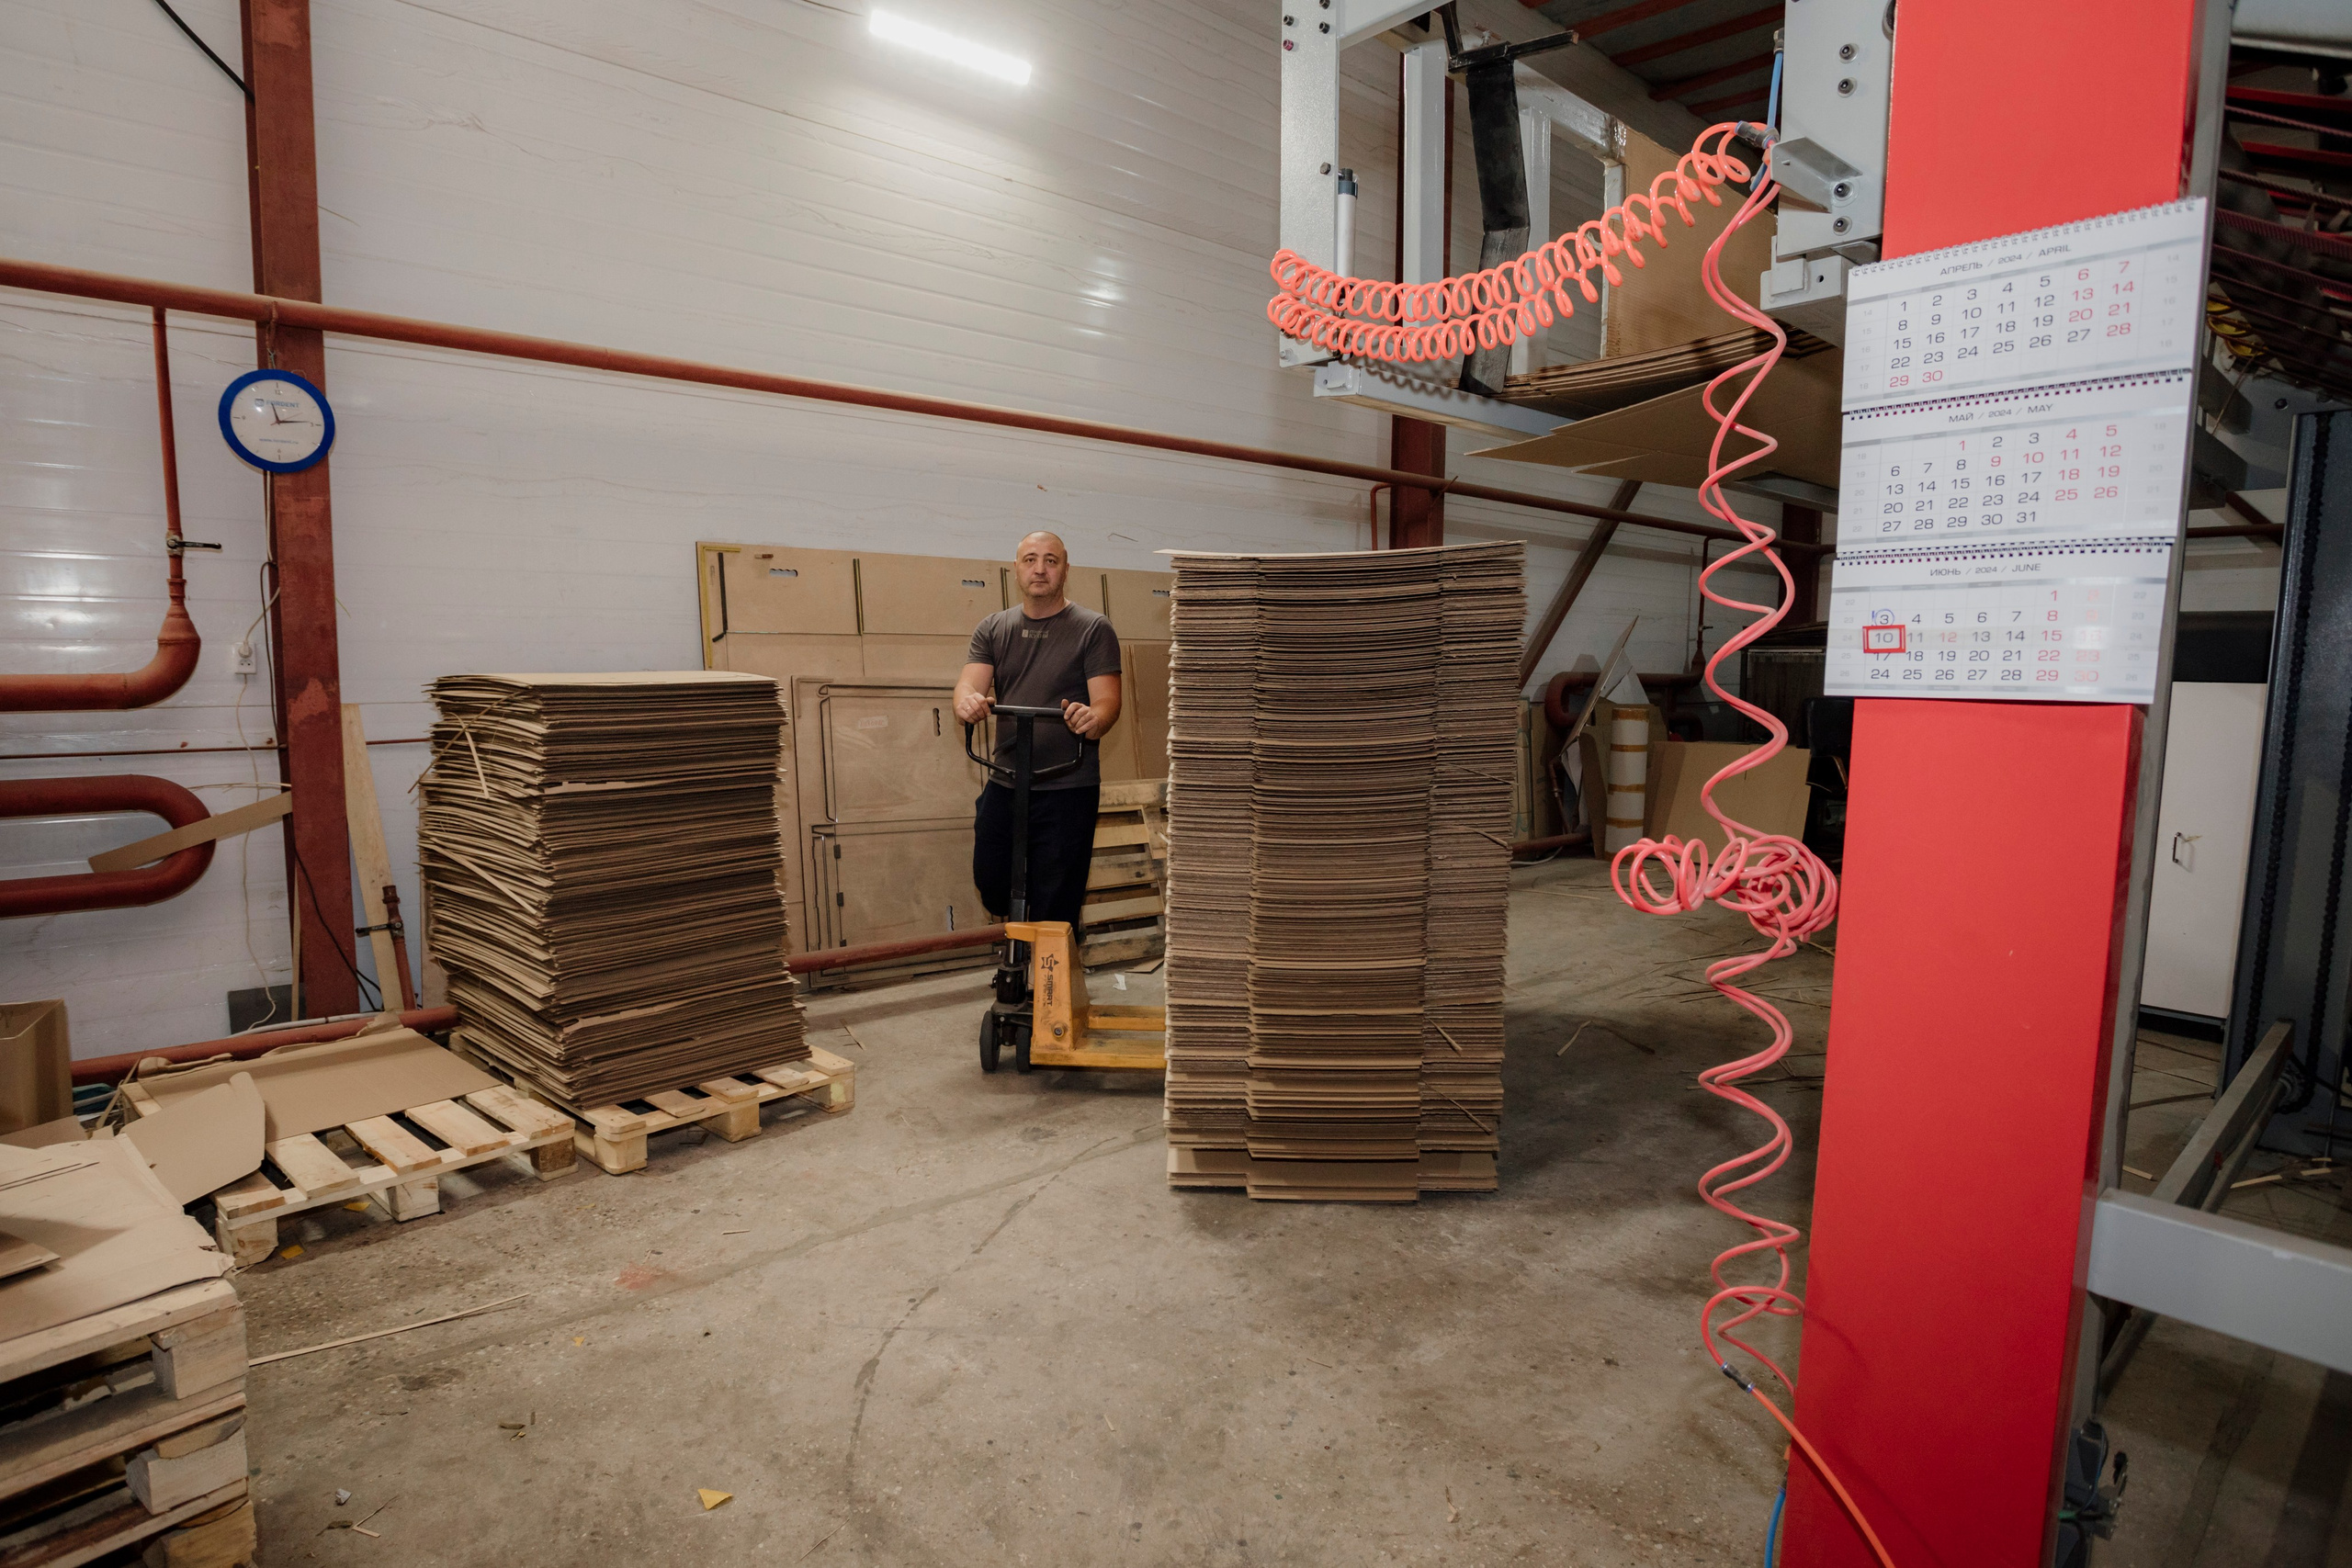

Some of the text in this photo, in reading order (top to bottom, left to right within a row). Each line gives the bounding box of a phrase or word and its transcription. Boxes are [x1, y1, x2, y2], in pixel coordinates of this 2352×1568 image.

[1939, 261, 1984, 276] АПРЕЛЬ
[1998, 254, 2022, 265] 2024
[2038, 243, 2072, 257] APRIL
[1863, 309, 1872, 317] 14
[1900, 300, 1907, 312] 1
[1932, 294, 1942, 307] 2
[1966, 288, 1977, 300] 3
[2002, 281, 2013, 293] 4
[2040, 275, 2051, 288] 5
[2077, 268, 2089, 281] 6
[2120, 260, 2130, 274] 7
[1897, 319, 1908, 332] 8
[1930, 313, 1941, 326] 9
[1962, 307, 1983, 320] 10
[1997, 300, 2015, 315] 11
[2034, 294, 2055, 308] 12
[2073, 288, 2094, 301] 13
[2112, 280, 2134, 295] 14
[1860, 345, 1871, 354] 16
[1893, 337, 1912, 350] 15
[1926, 332, 1945, 344] 16
[1960, 326, 1980, 340] 17
[1996, 321, 2017, 333] 18
[2032, 314, 2053, 328] 19
[2068, 308, 2093, 323] 20
[2108, 301, 2131, 317] 21
[1891, 355, 1911, 369] 22
[1923, 351, 1944, 365] 23
[1957, 345, 1979, 359] 24
[1992, 340, 2015, 355] 25
[2029, 334, 2052, 349] 26
[2066, 328, 2091, 344] 27
[2106, 322, 2132, 337] 28
[1889, 375, 1909, 388] 29
[1922, 369, 1943, 383] 30
[1949, 412, 1974, 423] МАЙ
[1988, 409, 2012, 418] 2024
[2027, 403, 2053, 413] MAY
[1857, 452, 1867, 460] 18
[1959, 440, 1965, 451] 1
[1992, 435, 2003, 448] 2
[2028, 432, 2040, 445] 3
[2065, 428, 2077, 440] 4
[2105, 424, 2118, 437] 5
[1856, 470, 1866, 479] 19
[1890, 465, 1901, 477] 6
[1923, 462, 1933, 474] 7
[1956, 458, 1967, 471] 8
[1990, 456, 2002, 468] 9
[2023, 451, 2044, 464] 10
[2061, 448, 2079, 461] 11
[2100, 445, 2122, 457] 12
[1885, 483, 1905, 496] 13
[1917, 480, 1937, 492] 14
[1951, 477, 1971, 490] 15
[1985, 474, 2006, 487] 16
[2021, 471, 2042, 484] 17
[2059, 468, 2080, 480] 18
[2098, 465, 2120, 478] 19
[1883, 502, 1904, 514] 20
[1915, 499, 1933, 512] 21
[1948, 496, 1969, 510] 22
[1982, 493, 2004, 507] 23
[2018, 491, 2041, 504] 24
[2054, 488, 2078, 502] 25
[2094, 486, 2118, 499] 26
[1852, 525, 1862, 533] 22
[1882, 520, 1902, 533] 27
[1914, 518, 1934, 531] 28
[1947, 515, 1968, 528] 29
[1981, 513, 2003, 526] 30
[2016, 511, 2036, 524] 31
[1929, 568, 1962, 577] ИЮНЬ
[1974, 566, 1997, 574] 2024
[2011, 563, 2041, 572] JUNE
[2051, 590, 2058, 602] 1
[2133, 592, 2147, 600] 22
[1879, 615, 1890, 626] 3
[1911, 614, 1921, 625] 4
[1944, 613, 1954, 625] 5
[1976, 611, 1987, 624] 6
[2011, 610, 2022, 622] 7
[2047, 609, 2059, 622] 8
[2132, 612, 2144, 620] 23
[1842, 634, 1852, 642] 24
[1873, 632, 1894, 643] 10
[1906, 632, 1923, 643] 11
[1938, 632, 1957, 643] 12
[1973, 630, 1991, 643] 13
[2006, 630, 2026, 642] 14
[2041, 629, 2063, 642] 15
[1872, 652, 1891, 662] 17
[1905, 650, 1924, 662] 18
[1938, 650, 1957, 661] 19
[1968, 649, 1990, 661] 20
[2002, 649, 2021, 661] 21
[2037, 649, 2061, 661] 22
[2075, 649, 2100, 662] 23
[2127, 653, 2141, 661] 25
[1871, 668, 1890, 680] 24
[1902, 669, 1923, 681] 25
[1935, 669, 1955, 681] 26
[1967, 669, 1987, 681] 27
[2000, 669, 2022, 681] 28
[2036, 669, 2059, 682] 29
[2074, 670, 2099, 682] 30
[2125, 673, 2138, 682] 26
